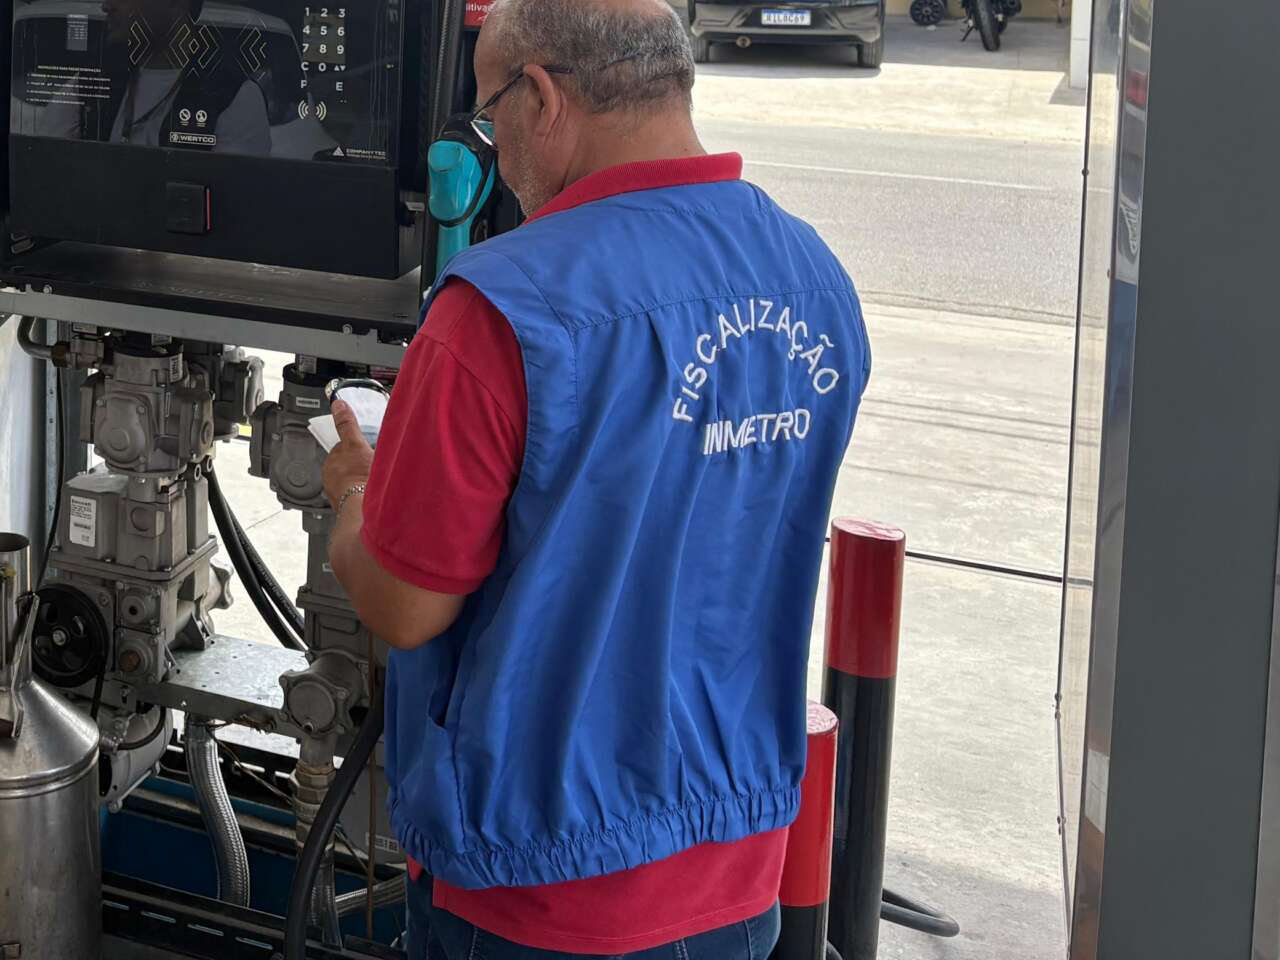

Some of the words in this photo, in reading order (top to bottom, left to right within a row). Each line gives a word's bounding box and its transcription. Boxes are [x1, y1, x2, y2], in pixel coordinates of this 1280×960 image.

[305, 7, 310, 16] 1
[320, 8, 328, 17] 2
[338, 8, 346, 18] 3
[302, 25, 310, 34] 4
[320, 26, 327, 35] 5
[337, 26, 345, 36] 6
[302, 43, 309, 53] 7
[320, 44, 327, 53] 8
[337, 45, 344, 54] 9
[301, 62, 309, 71] C
[335, 82, 343, 91] E
[180, 135, 214, 143] WERTCO
[672, 298, 840, 423] FISCALIZAÇÃO
[703, 408, 811, 456] INMETRO
